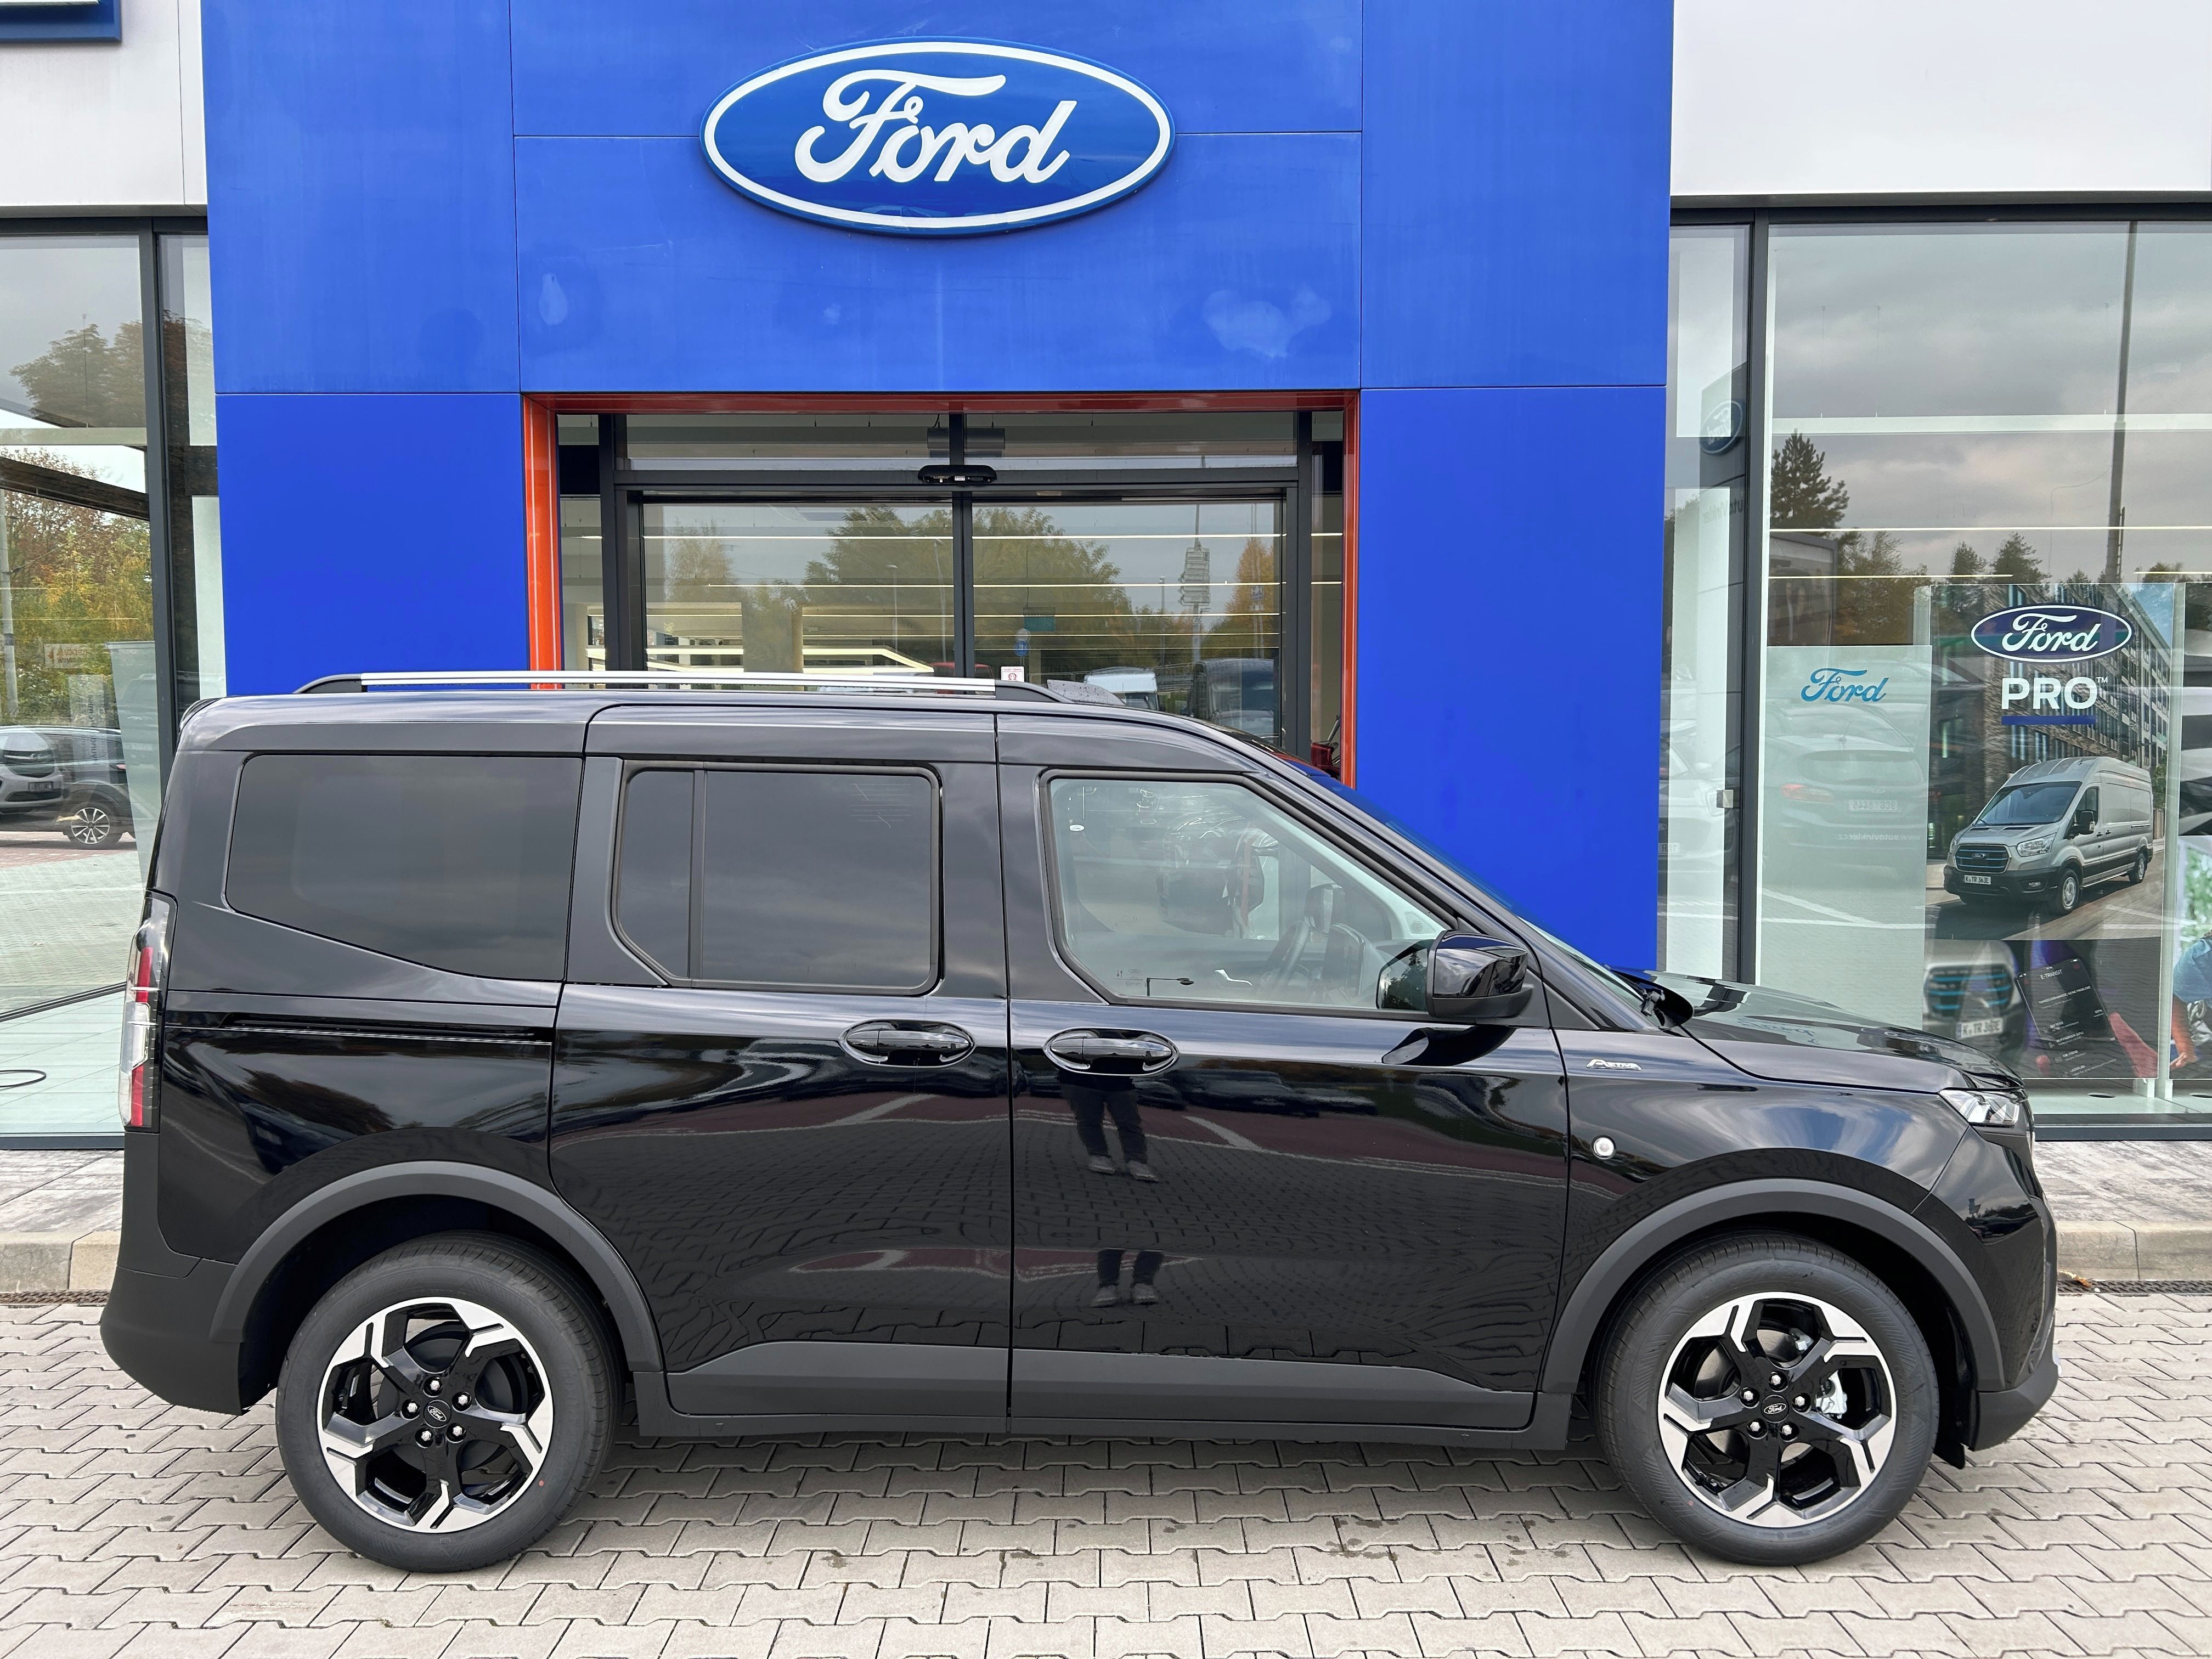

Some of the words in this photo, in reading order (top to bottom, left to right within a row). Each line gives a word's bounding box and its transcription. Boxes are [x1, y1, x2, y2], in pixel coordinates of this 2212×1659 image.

[795, 69, 1077, 183] Ford
[2002, 613, 2101, 652] Ford
[1801, 668, 1889, 702] Ford
[2001, 676, 2097, 709] PRO
[430, 1407, 444, 1420] Ford
[1768, 1404, 1783, 1413] Ford
